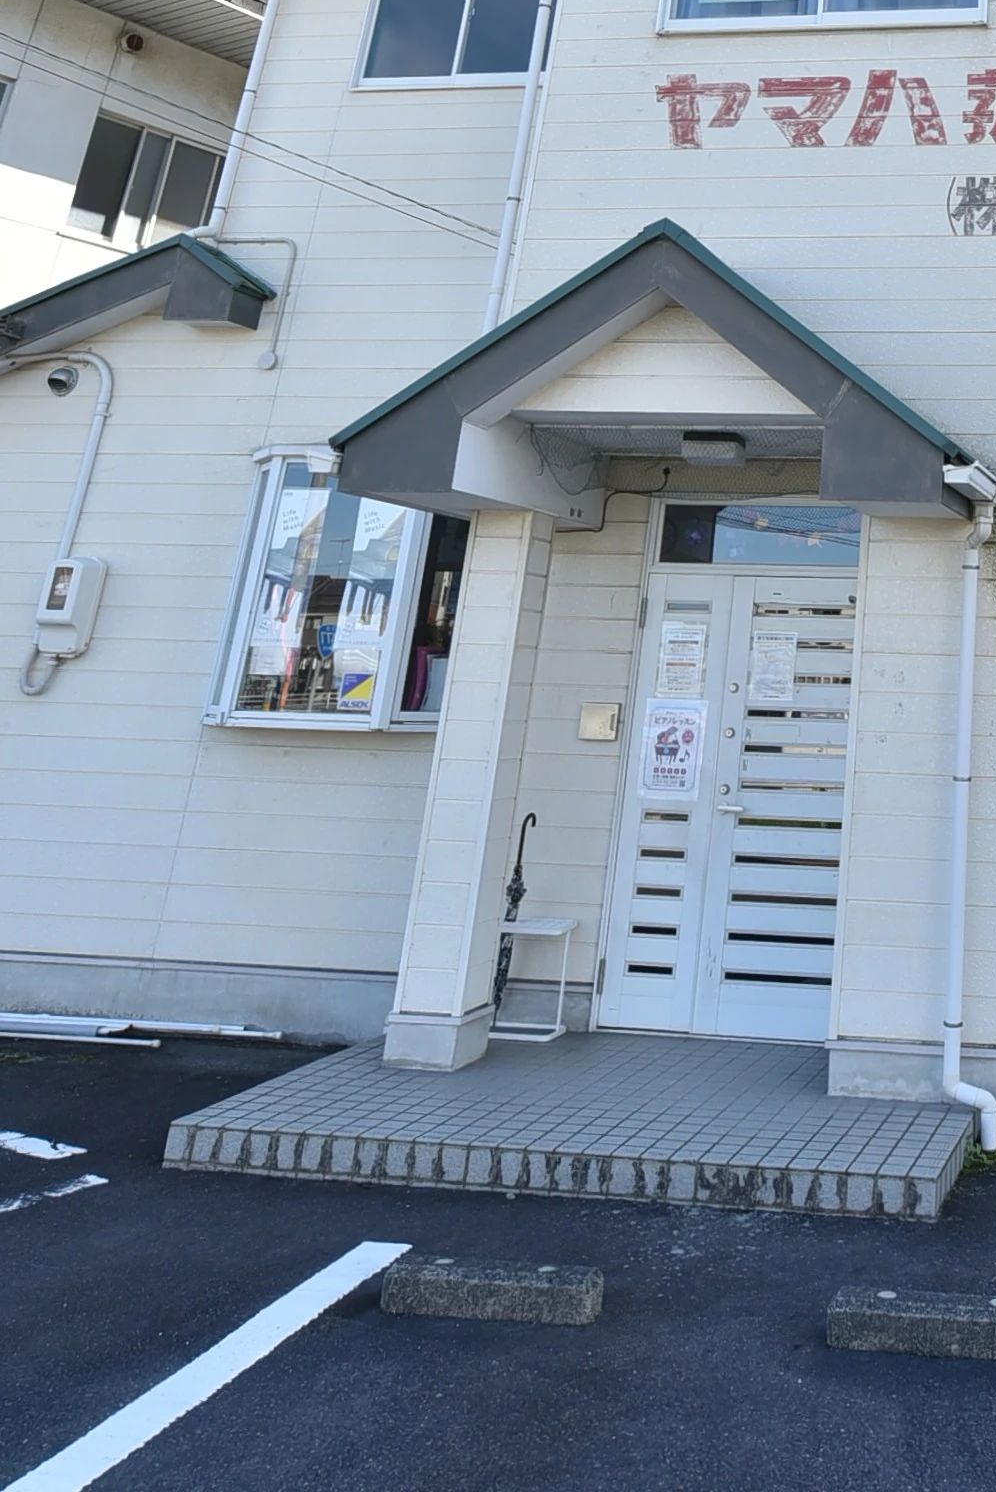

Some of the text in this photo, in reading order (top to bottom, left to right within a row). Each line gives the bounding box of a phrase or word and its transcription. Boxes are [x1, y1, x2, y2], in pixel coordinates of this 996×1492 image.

[340, 700, 369, 709] ALSOK
[654, 715, 697, 726] ピアノレッスン
